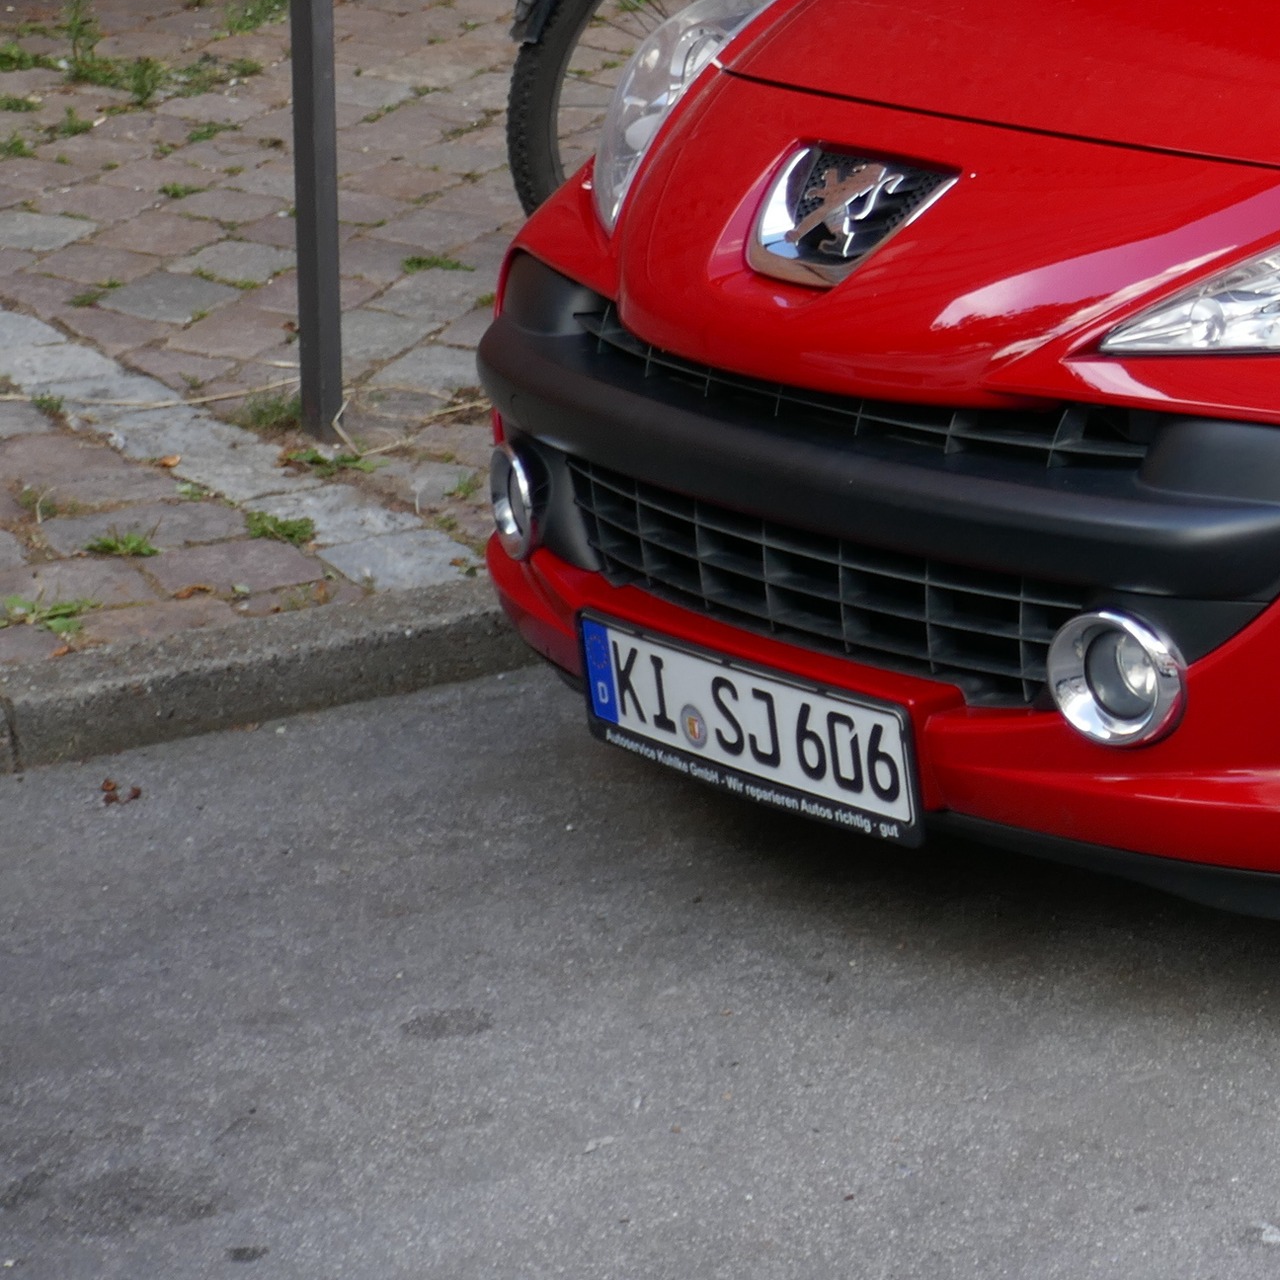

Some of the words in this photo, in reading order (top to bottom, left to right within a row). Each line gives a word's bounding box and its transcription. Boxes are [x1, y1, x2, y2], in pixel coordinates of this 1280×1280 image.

[597, 681, 609, 704] D
[612, 640, 677, 735] KI
[711, 676, 781, 768] SJ
[796, 703, 900, 803] 606
[606, 728, 656, 761] Autoservice
[690, 762, 719, 785] GmbH
[726, 775, 743, 793] Wir
[746, 782, 799, 811] reparieren
[801, 798, 833, 820] Autos
[835, 809, 872, 833] richtig
[879, 822, 899, 838] gut
